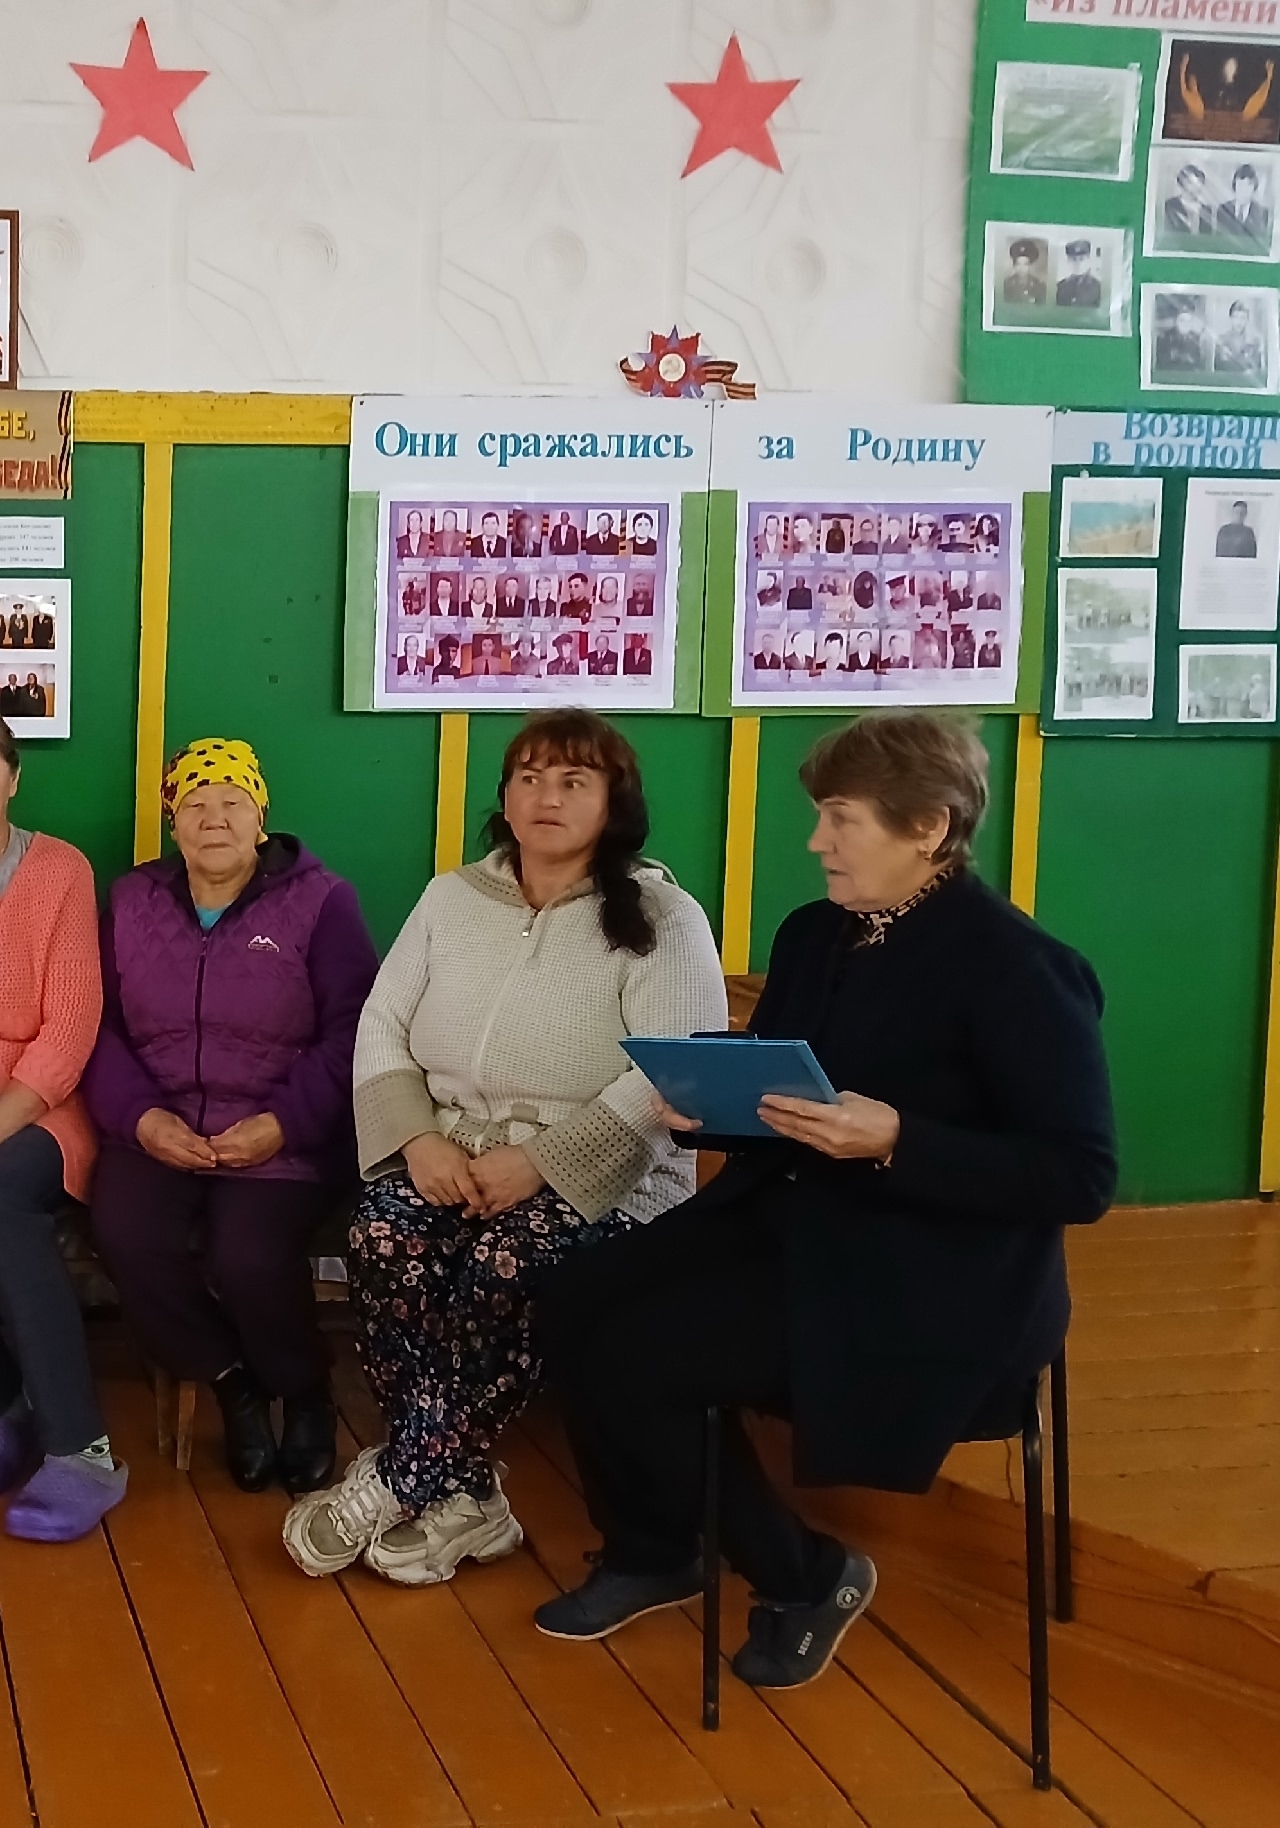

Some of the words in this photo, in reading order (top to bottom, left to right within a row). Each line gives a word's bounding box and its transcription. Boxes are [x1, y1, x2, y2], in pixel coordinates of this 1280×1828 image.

[375, 421, 458, 457] Они
[477, 432, 695, 467] сражались
[758, 435, 796, 460] за
[847, 427, 986, 472] Родину
[1092, 441, 1111, 464] в
[1132, 438, 1263, 474] родной
